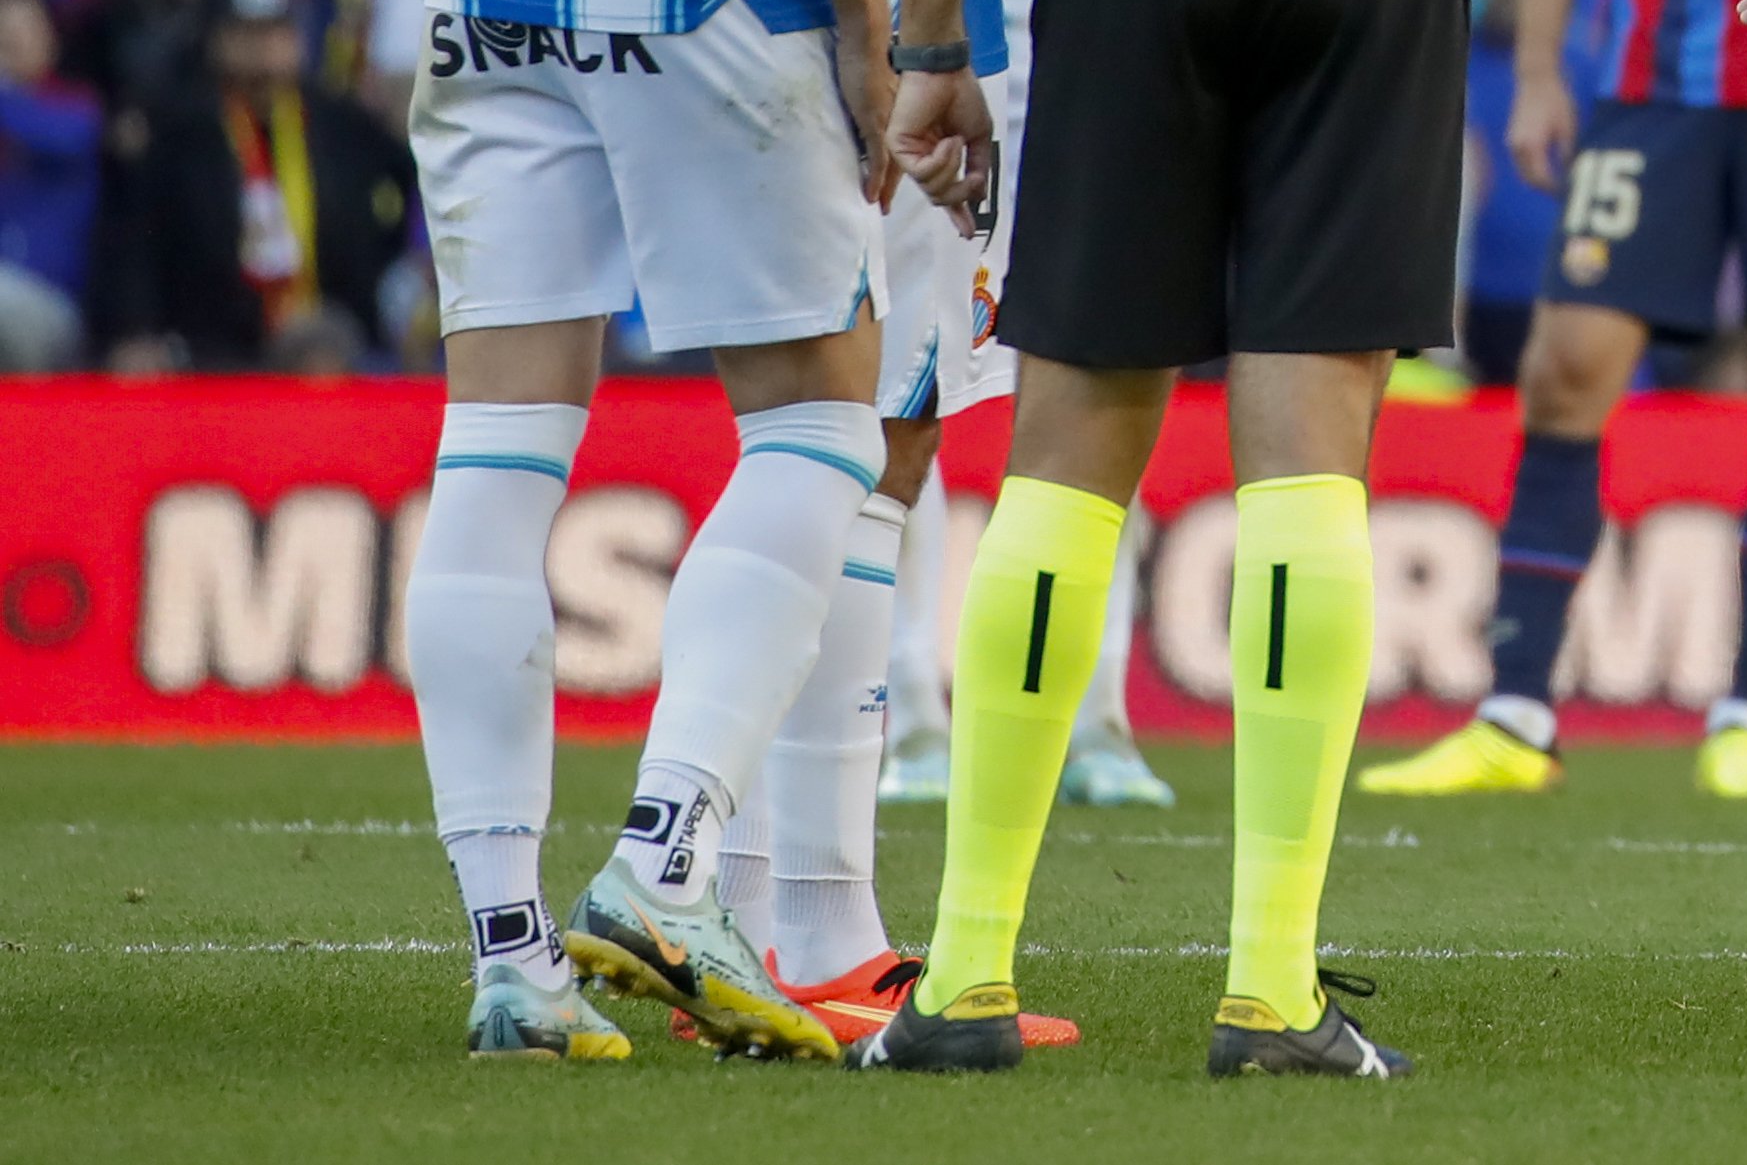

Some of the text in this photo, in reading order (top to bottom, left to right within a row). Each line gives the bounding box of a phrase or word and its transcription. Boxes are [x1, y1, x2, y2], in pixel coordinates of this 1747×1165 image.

[429, 12, 663, 78] SNACK
[1565, 148, 1648, 241] 15
[140, 480, 690, 698] MS
